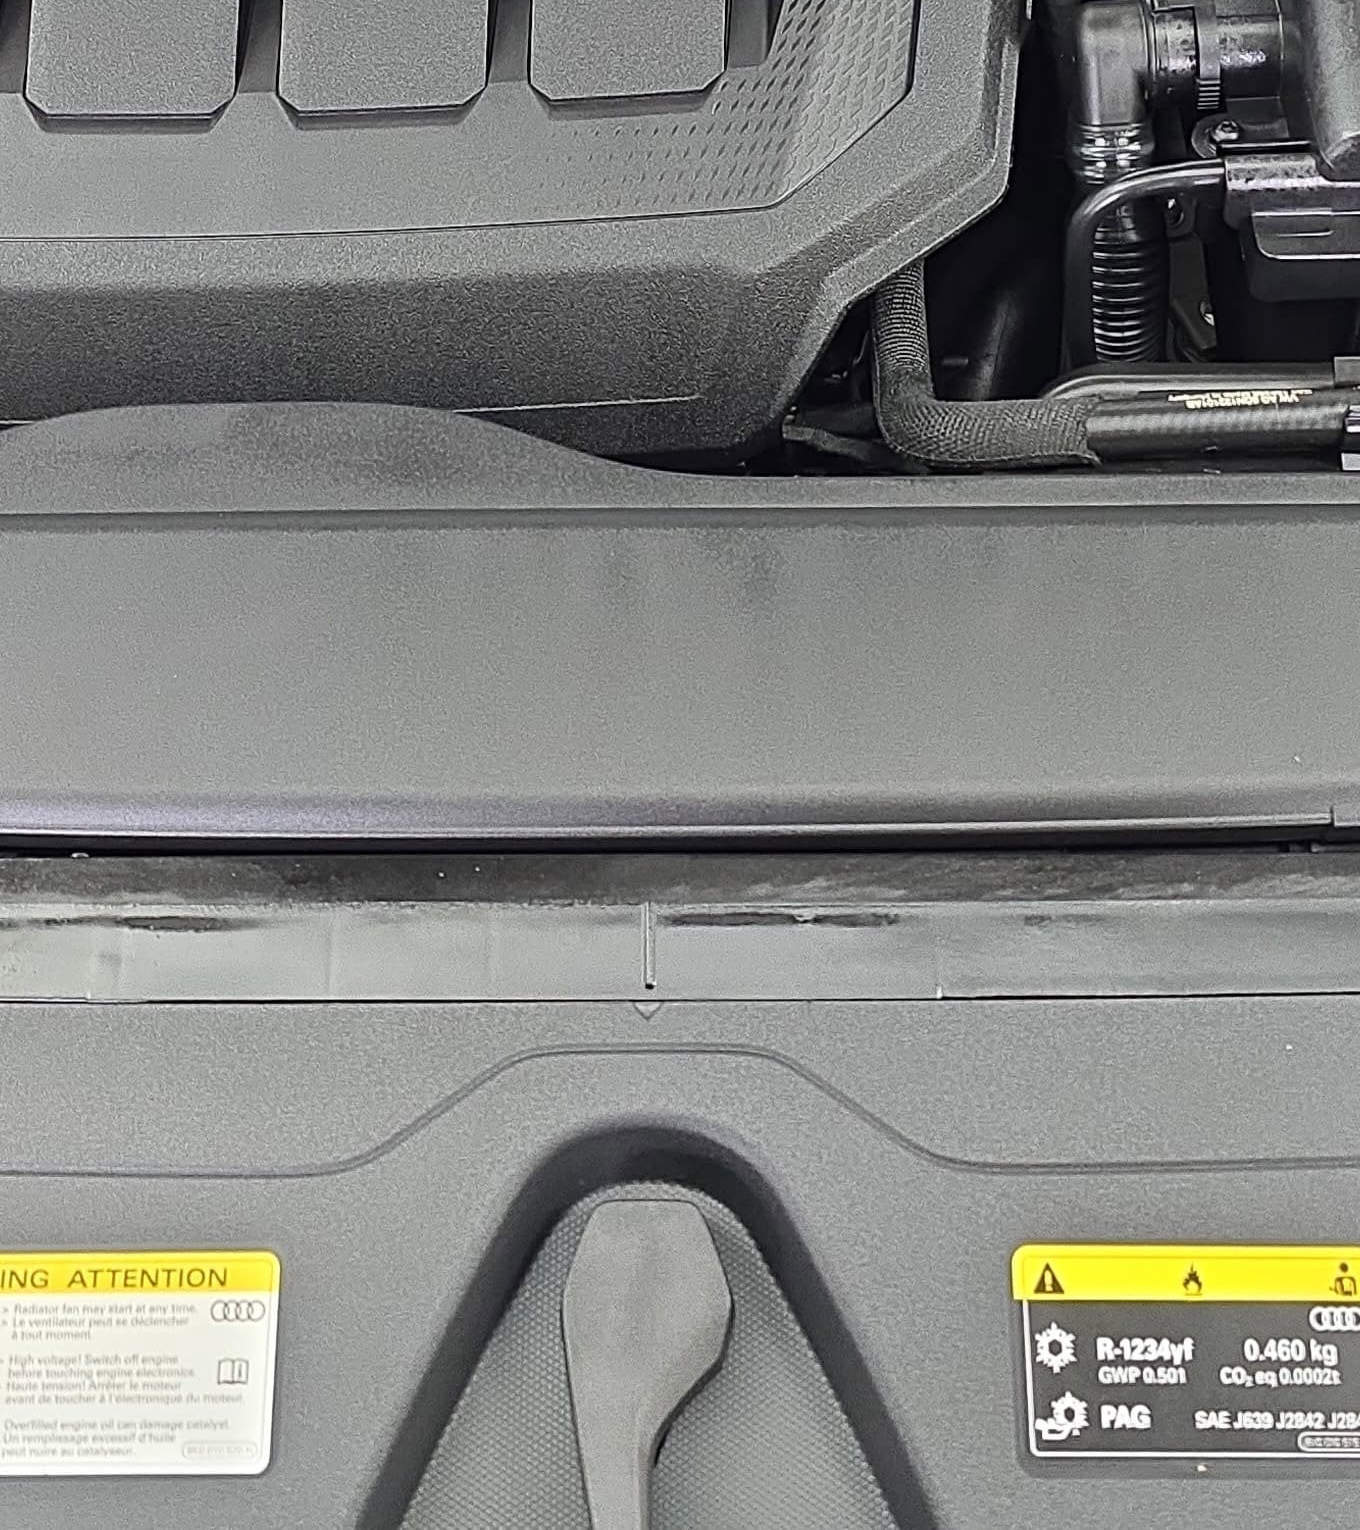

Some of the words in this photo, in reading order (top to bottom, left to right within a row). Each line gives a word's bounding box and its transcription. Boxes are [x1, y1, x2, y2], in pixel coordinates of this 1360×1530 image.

[67, 1268, 228, 1289] ATTENTION
[13, 1303, 60, 1315] Radiator
[62, 1303, 80, 1314] fan
[82, 1305, 105, 1317] may
[108, 1303, 132, 1314] start
[135, 1303, 146, 1314] at
[148, 1304, 169, 1317] any
[13, 1318, 25, 1327] Le
[28, 1316, 85, 1327] ventilateur
[88, 1317, 112, 1329] peut
[115, 1318, 127, 1327] se
[21, 1330, 42, 1340] tout
[9, 1355, 35, 1367] High
[84, 1354, 122, 1365] Switch
[141, 1355, 179, 1367] engine
[1096, 1337, 1196, 1365] R-1234yf
[1243, 1338, 1306, 1362] 0.460
[1310, 1338, 1339, 1367] kg
[1097, 1366, 1142, 1385] GWP
[1142, 1366, 1187, 1385] 0.501
[1254, 1371, 1278, 1388] eq
[1100, 1404, 1152, 1430] PAG
[1194, 1411, 1231, 1430] SAE
[1232, 1411, 1274, 1430] J639
[1275, 1412, 1325, 1430] J2842
